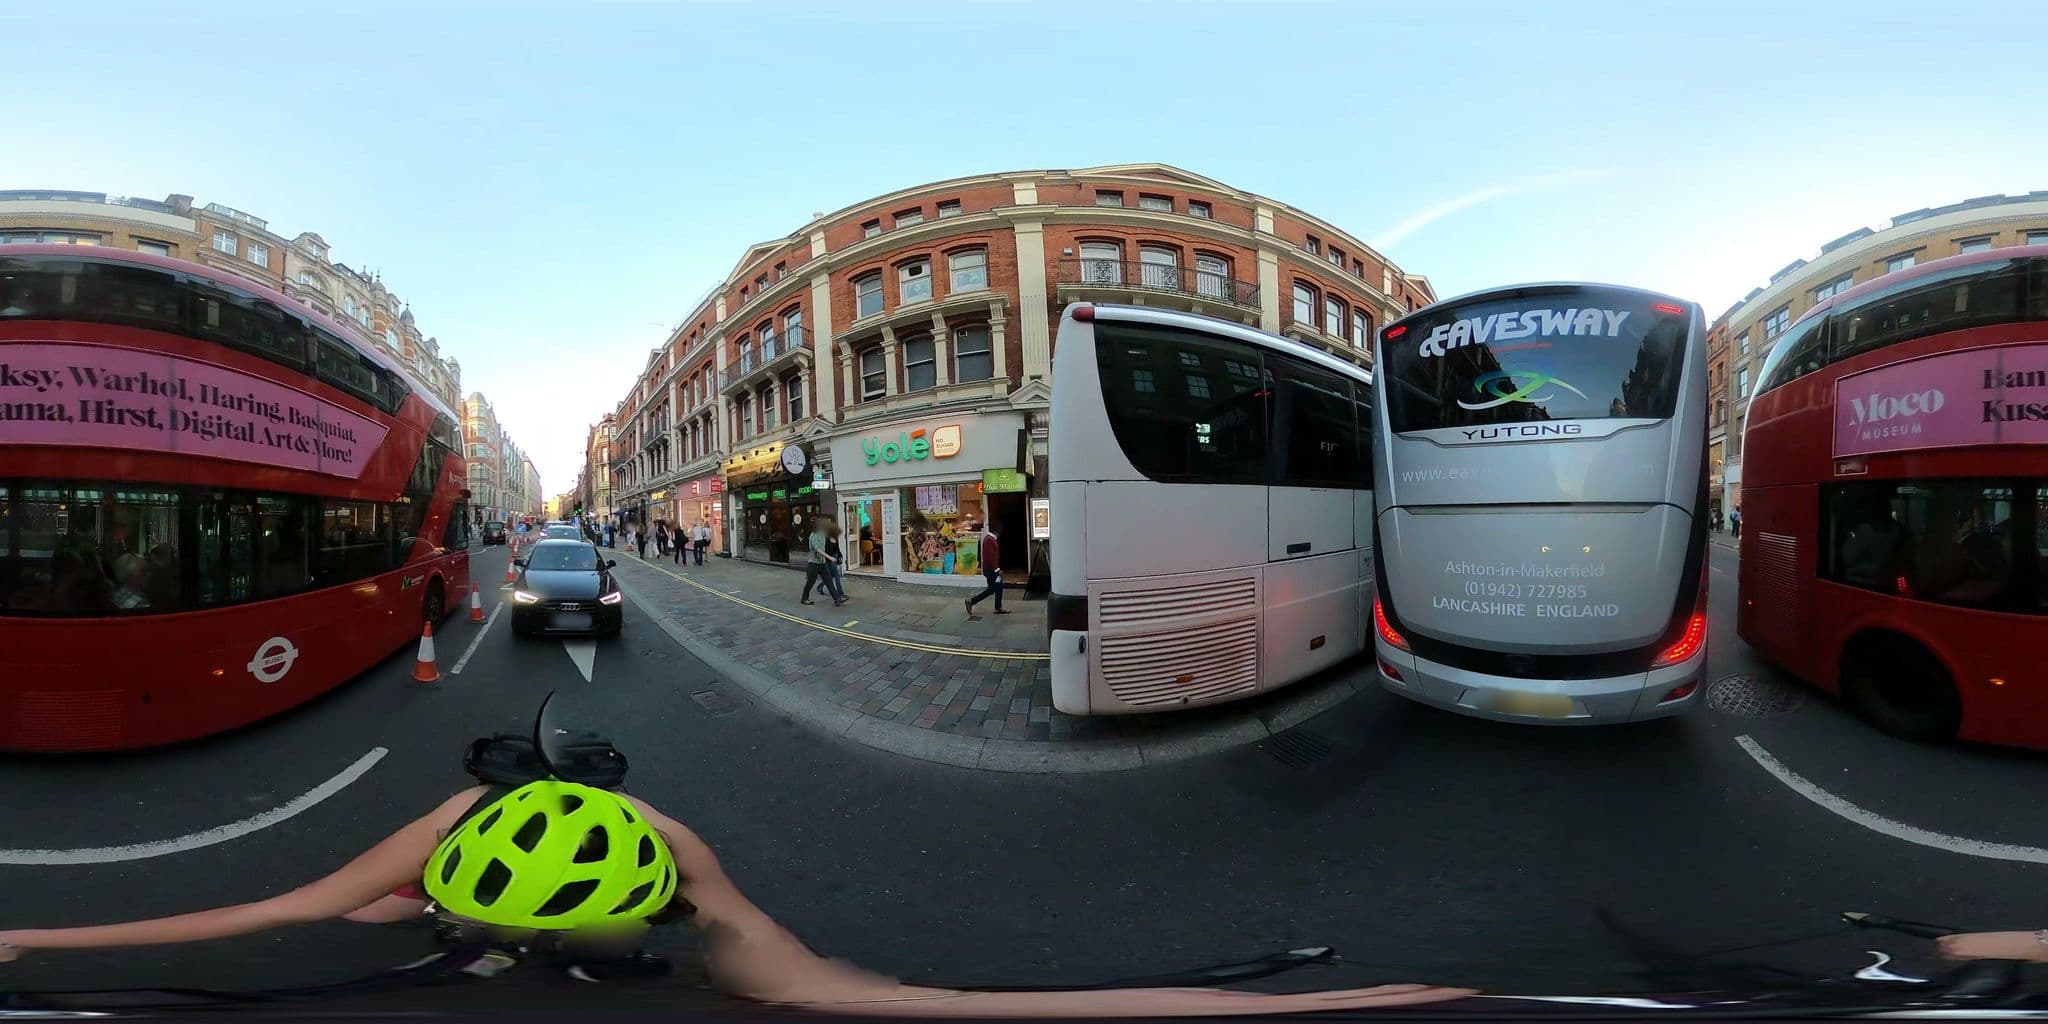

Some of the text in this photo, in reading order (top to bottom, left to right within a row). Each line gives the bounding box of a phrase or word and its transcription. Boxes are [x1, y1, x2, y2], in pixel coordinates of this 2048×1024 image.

[1419, 308, 1631, 358] EAVESWAY
[67, 366, 194, 402] Warhol,
[200, 383, 285, 424] Haring,
[289, 406, 357, 444] Basquiat,
[1848, 389, 1945, 434] Moco
[79, 399, 164, 431] Hirst,
[169, 408, 255, 443] Digital
[259, 426, 293, 450] Art
[295, 434, 310, 453] &
[312, 438, 352, 463] More!
[1462, 424, 1581, 440] YUTONG
[1862, 422, 1922, 441] MUSEUM
[1445, 560, 1605, 577] Ashton-in-Makerfield
[1465, 581, 1587, 599] (01942) 727985
[1433, 595, 1619, 618] LANCASHIRE ENGLAND
